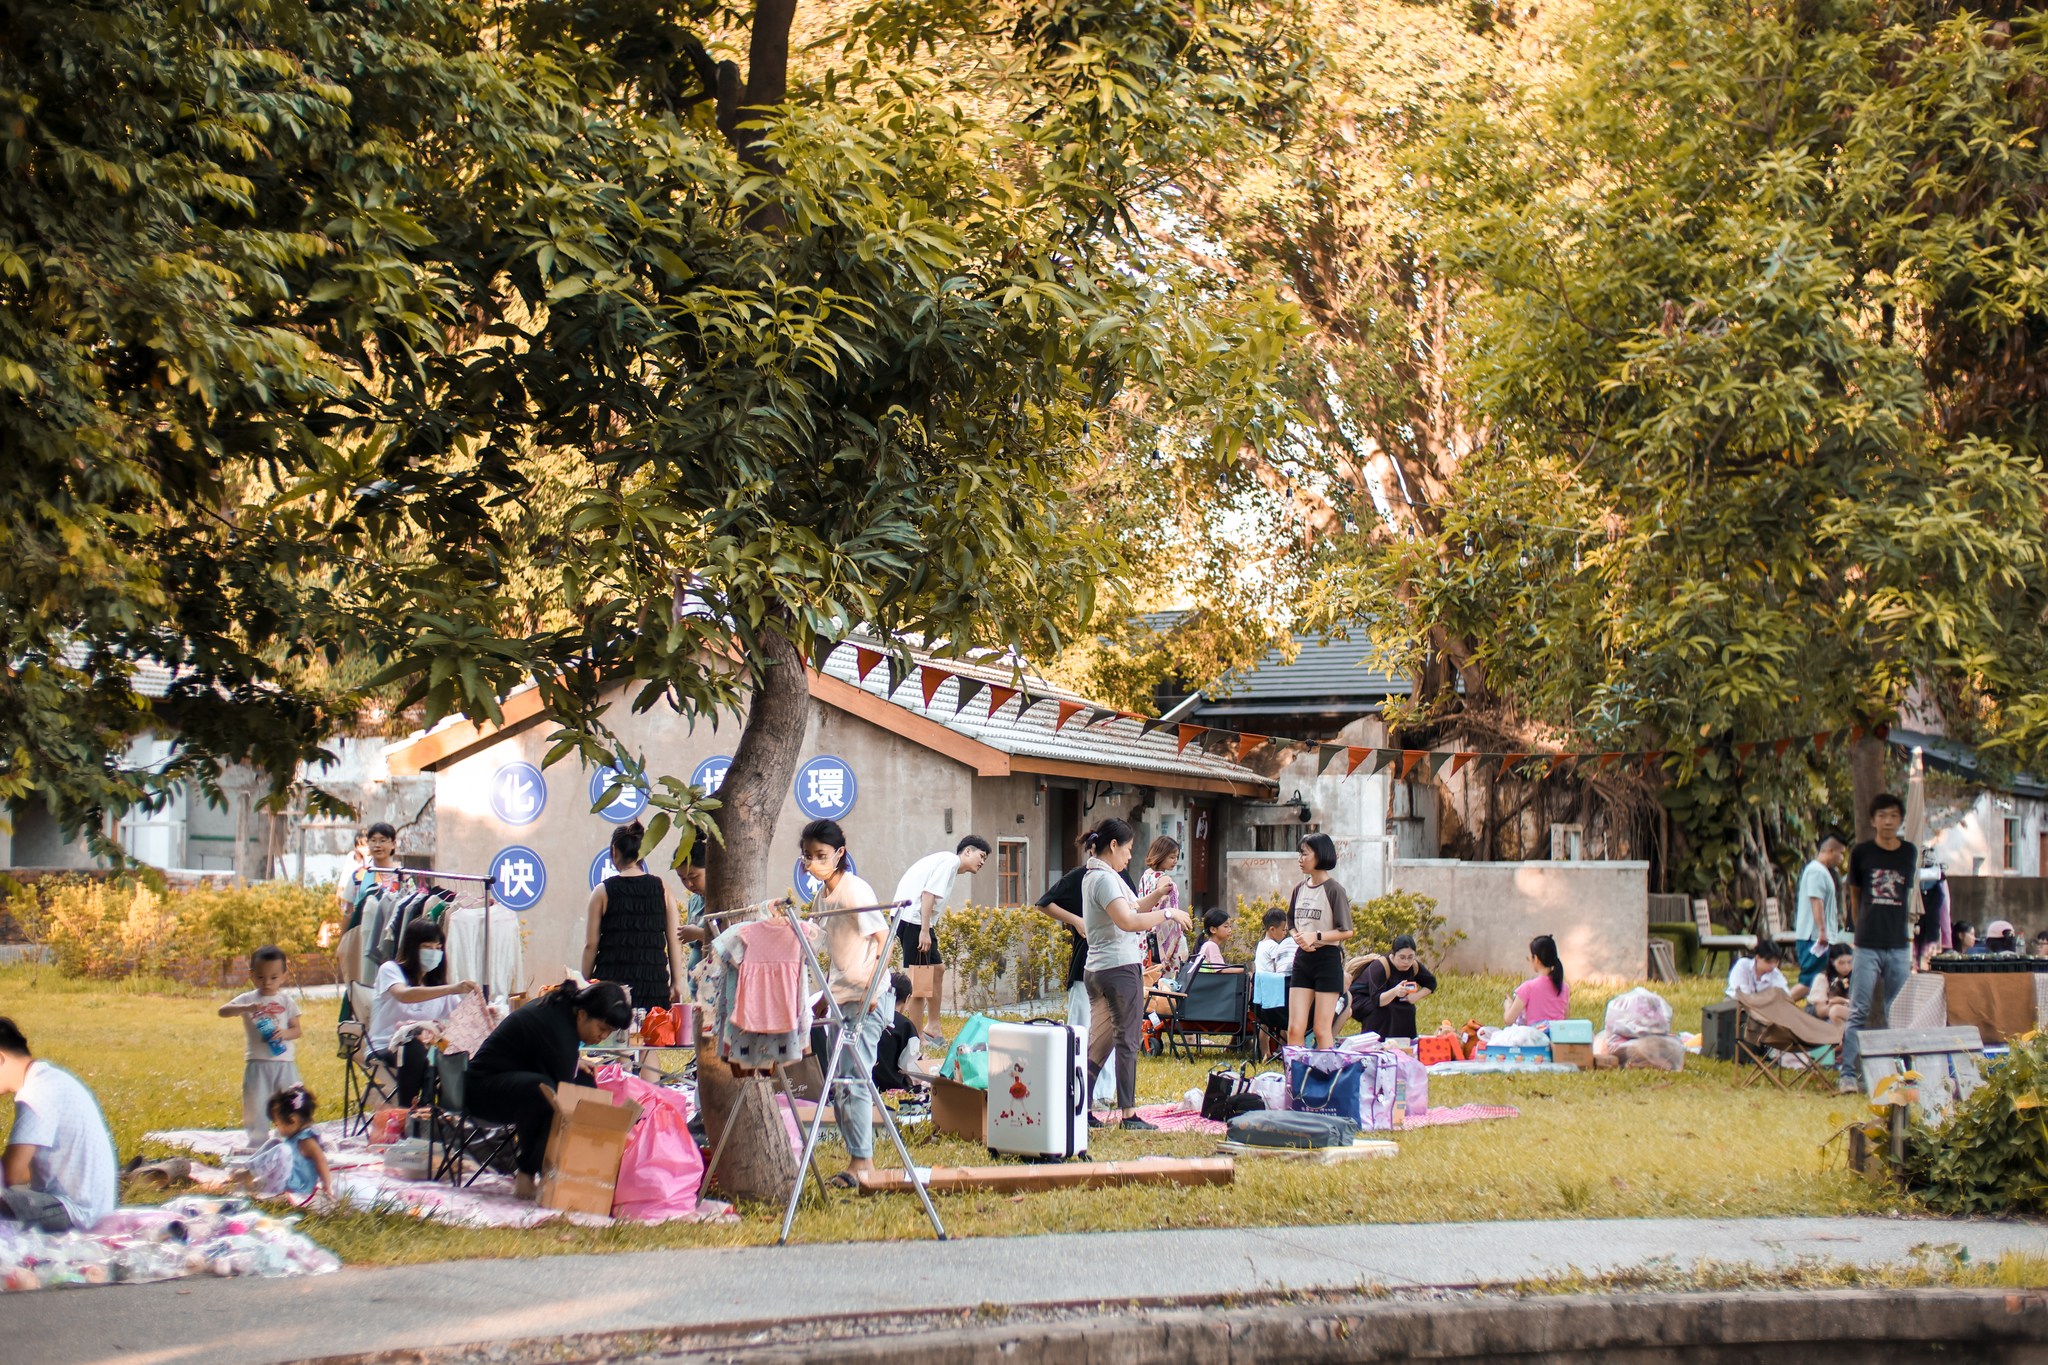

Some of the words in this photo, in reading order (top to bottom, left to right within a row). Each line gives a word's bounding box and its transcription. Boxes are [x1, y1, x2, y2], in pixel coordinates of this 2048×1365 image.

[502, 773, 535, 813] 化
[807, 768, 845, 809] 環
[499, 858, 535, 898] 快
